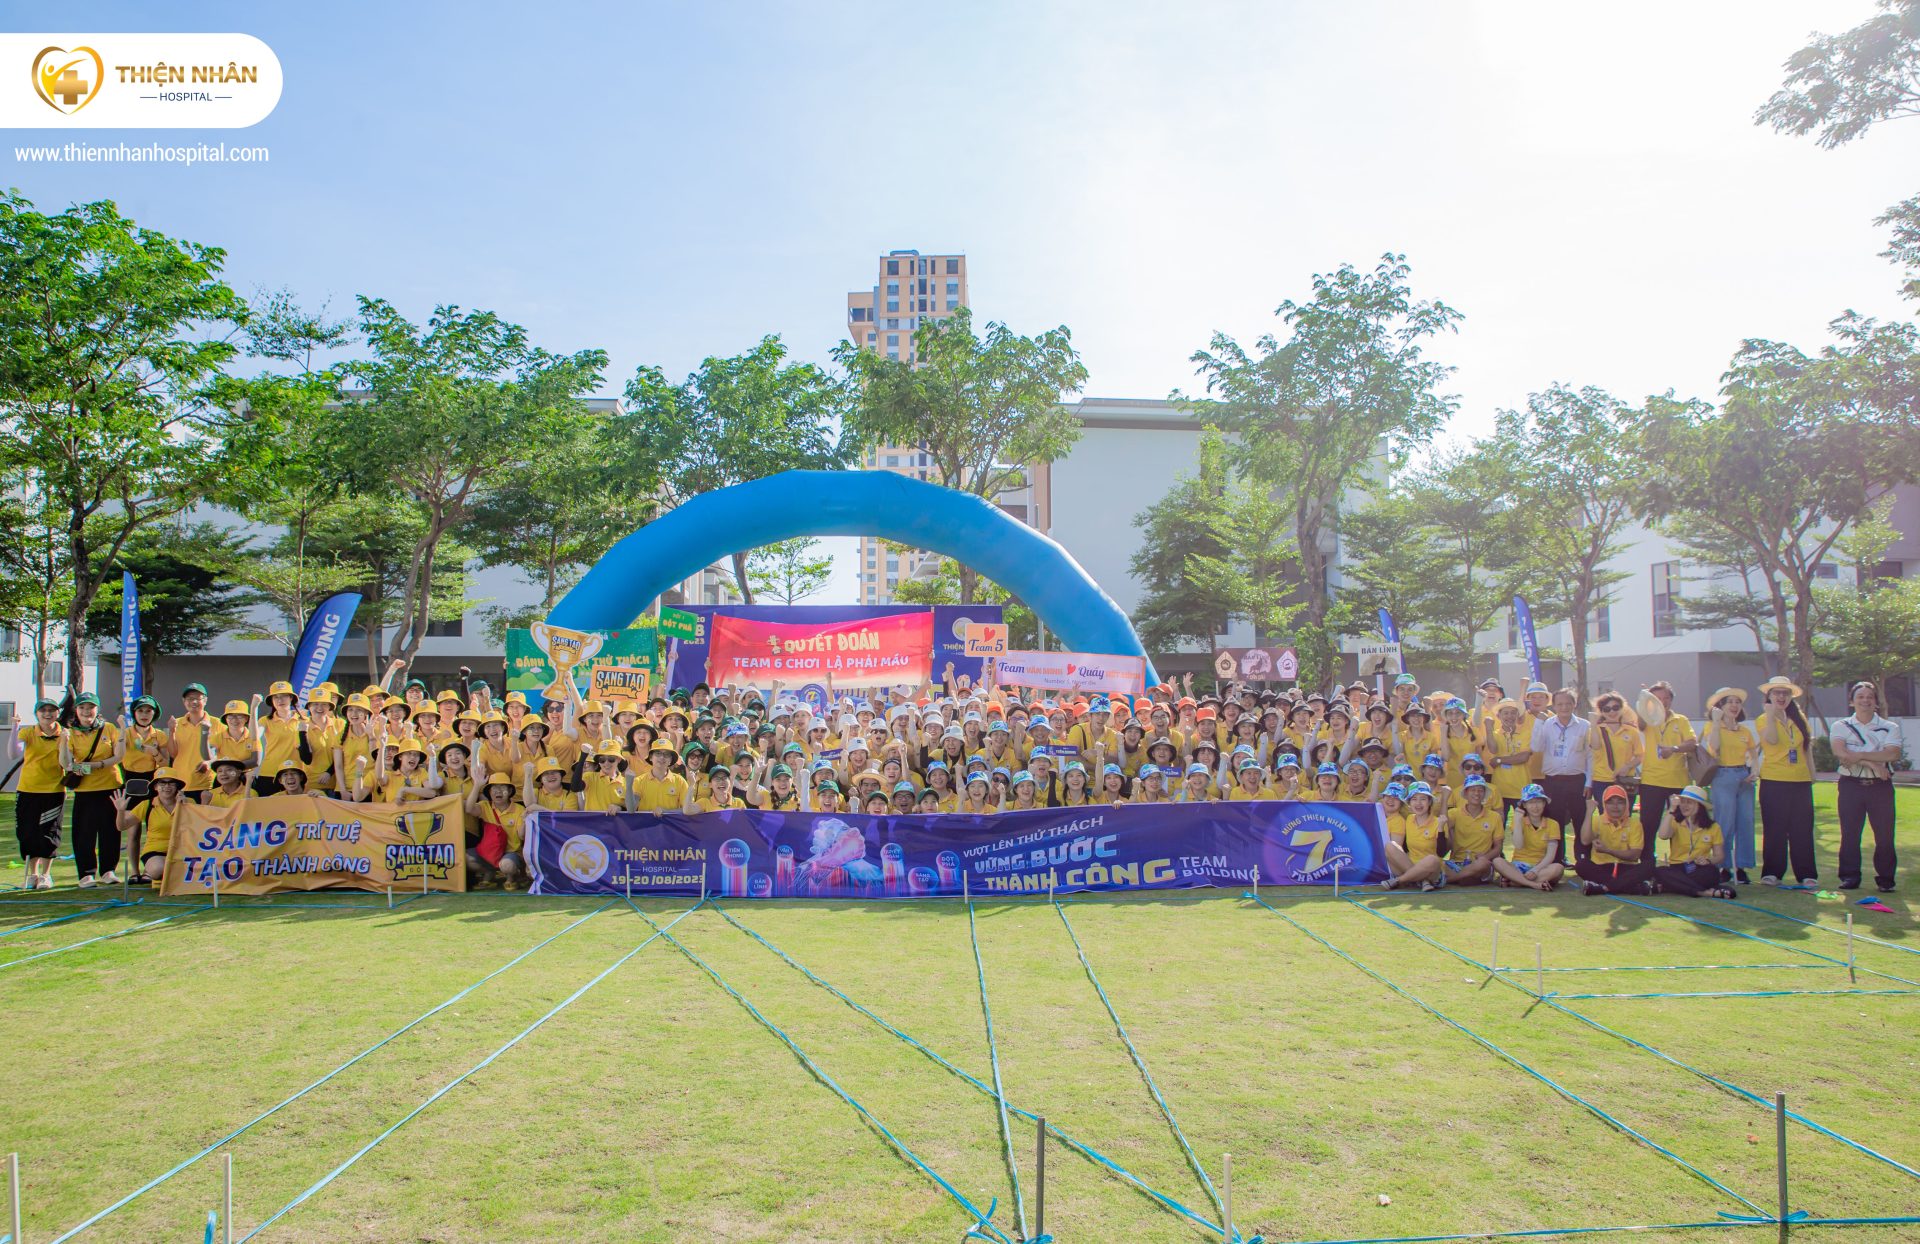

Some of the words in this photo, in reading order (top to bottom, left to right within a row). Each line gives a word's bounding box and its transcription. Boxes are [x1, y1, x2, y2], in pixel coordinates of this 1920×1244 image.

[784, 633, 833, 654] QUYẾT
[837, 628, 880, 651] ĐOÁN
[968, 639, 993, 652] Team
[994, 639, 1004, 652] 5
[616, 654, 650, 665] THÁCH
[733, 657, 771, 668] TEAM
[774, 658, 783, 669] 6
[786, 658, 820, 669] CHƠI
[846, 654, 878, 668] PHẢI
[998, 662, 1025, 674] Team
[1281, 818, 1302, 836] MỪNG
[1302, 813, 1325, 822] THIỆN
[1326, 817, 1348, 832] NHÂN
[198, 819, 288, 851] SÁNG
[296, 819, 324, 840] TRÍ
[326, 820, 362, 843] TUỆ
[963, 844, 990, 858] VƯỢT
[993, 839, 1014, 851] LÊN
[1017, 829, 1045, 845] THỬ
[1048, 815, 1104, 837] THÁCH
[386, 845, 425, 870] SÁNG
[427, 844, 455, 869] TẠO
[614, 847, 659, 863] THIỆN
[663, 847, 706, 861] NHÂN
[975, 853, 1025, 873] VỮNG
[1030, 834, 1118, 868] BƯỚC
[1290, 829, 1333, 872] 7
[1333, 845, 1351, 853] năm
[184, 856, 245, 887] TẠO
[252, 854, 318, 876] THÀNH
[321, 853, 371, 875] CÔNG
[1180, 855, 1227, 869] TEAM
[611, 875, 650, 885] 19-20
[985, 873, 1058, 891] THÀNH
[1066, 858, 1176, 886] CÔNG
[1182, 864, 1261, 883] BUILDING
[1291, 867, 1329, 882] THÀNH
